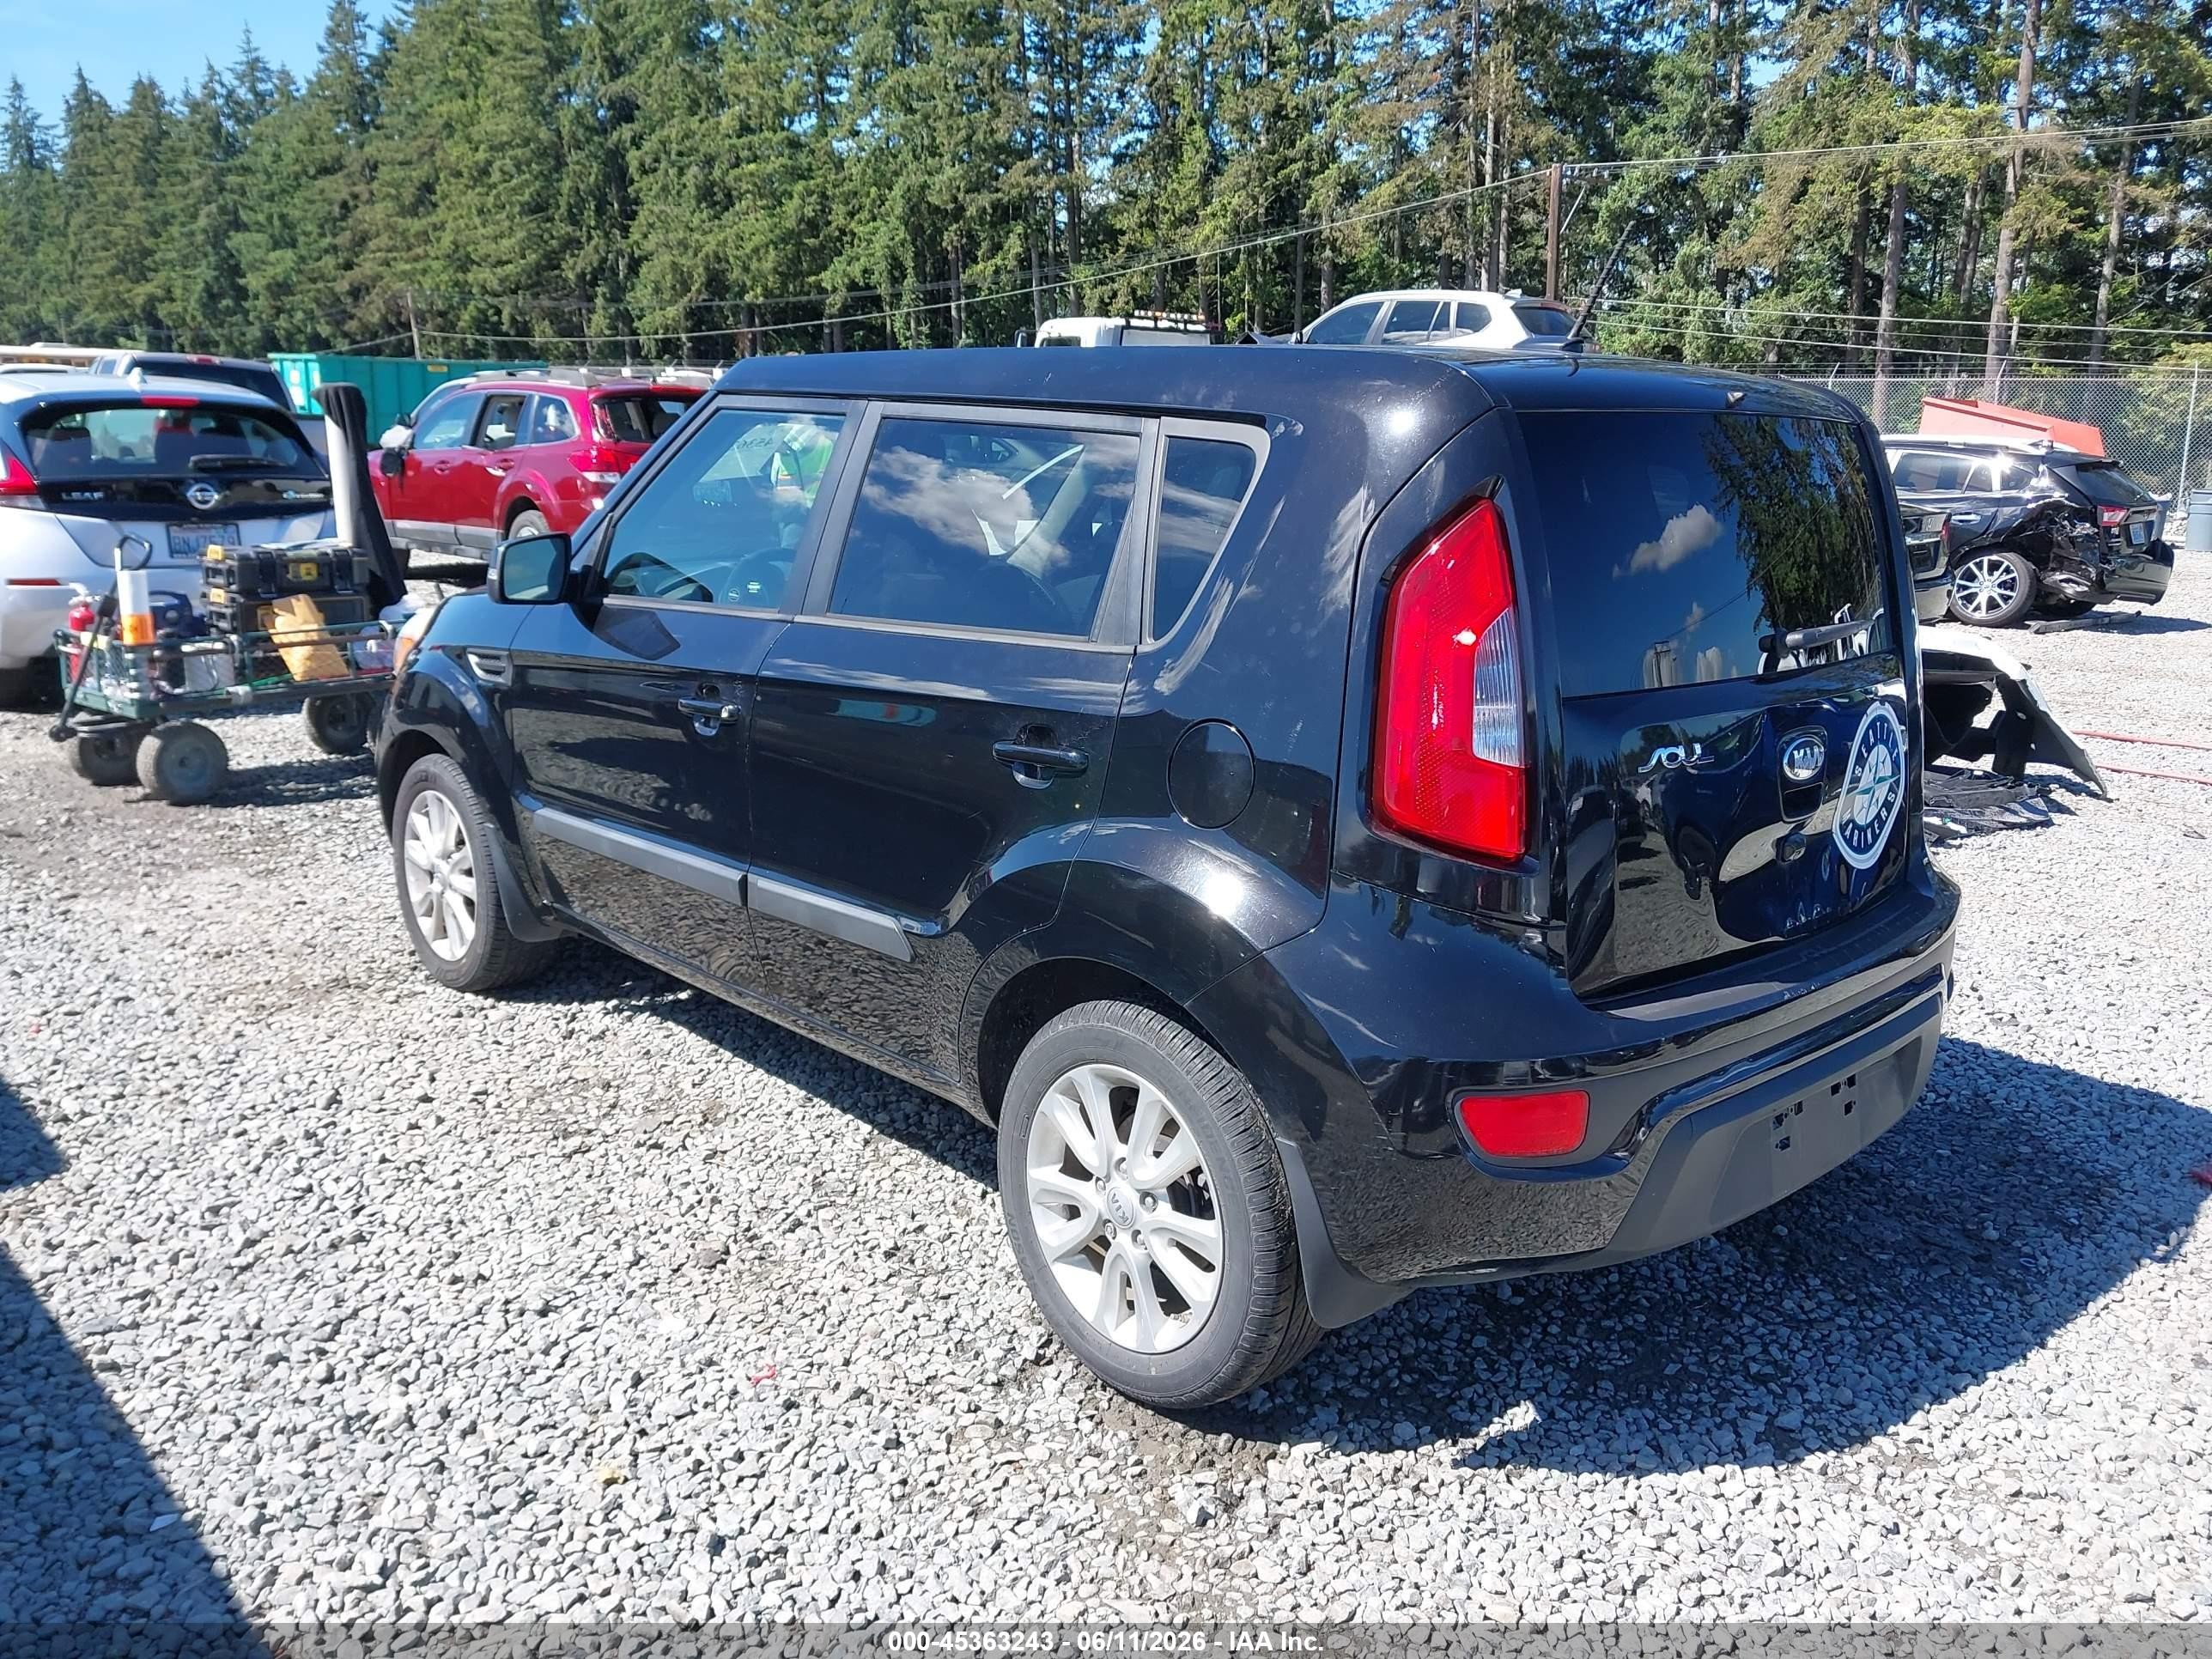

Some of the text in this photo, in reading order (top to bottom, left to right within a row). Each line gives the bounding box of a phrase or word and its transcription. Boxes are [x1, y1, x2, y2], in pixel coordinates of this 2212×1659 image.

[61, 491, 104, 501] LEAF
[1638, 743, 1715, 773] SOUL
[1792, 744, 1823, 771] KIA
[1855, 721, 1899, 777] SEATTLE
[1841, 791, 1896, 849] MARINERS
[1110, 1192, 1130, 1224] KIA
